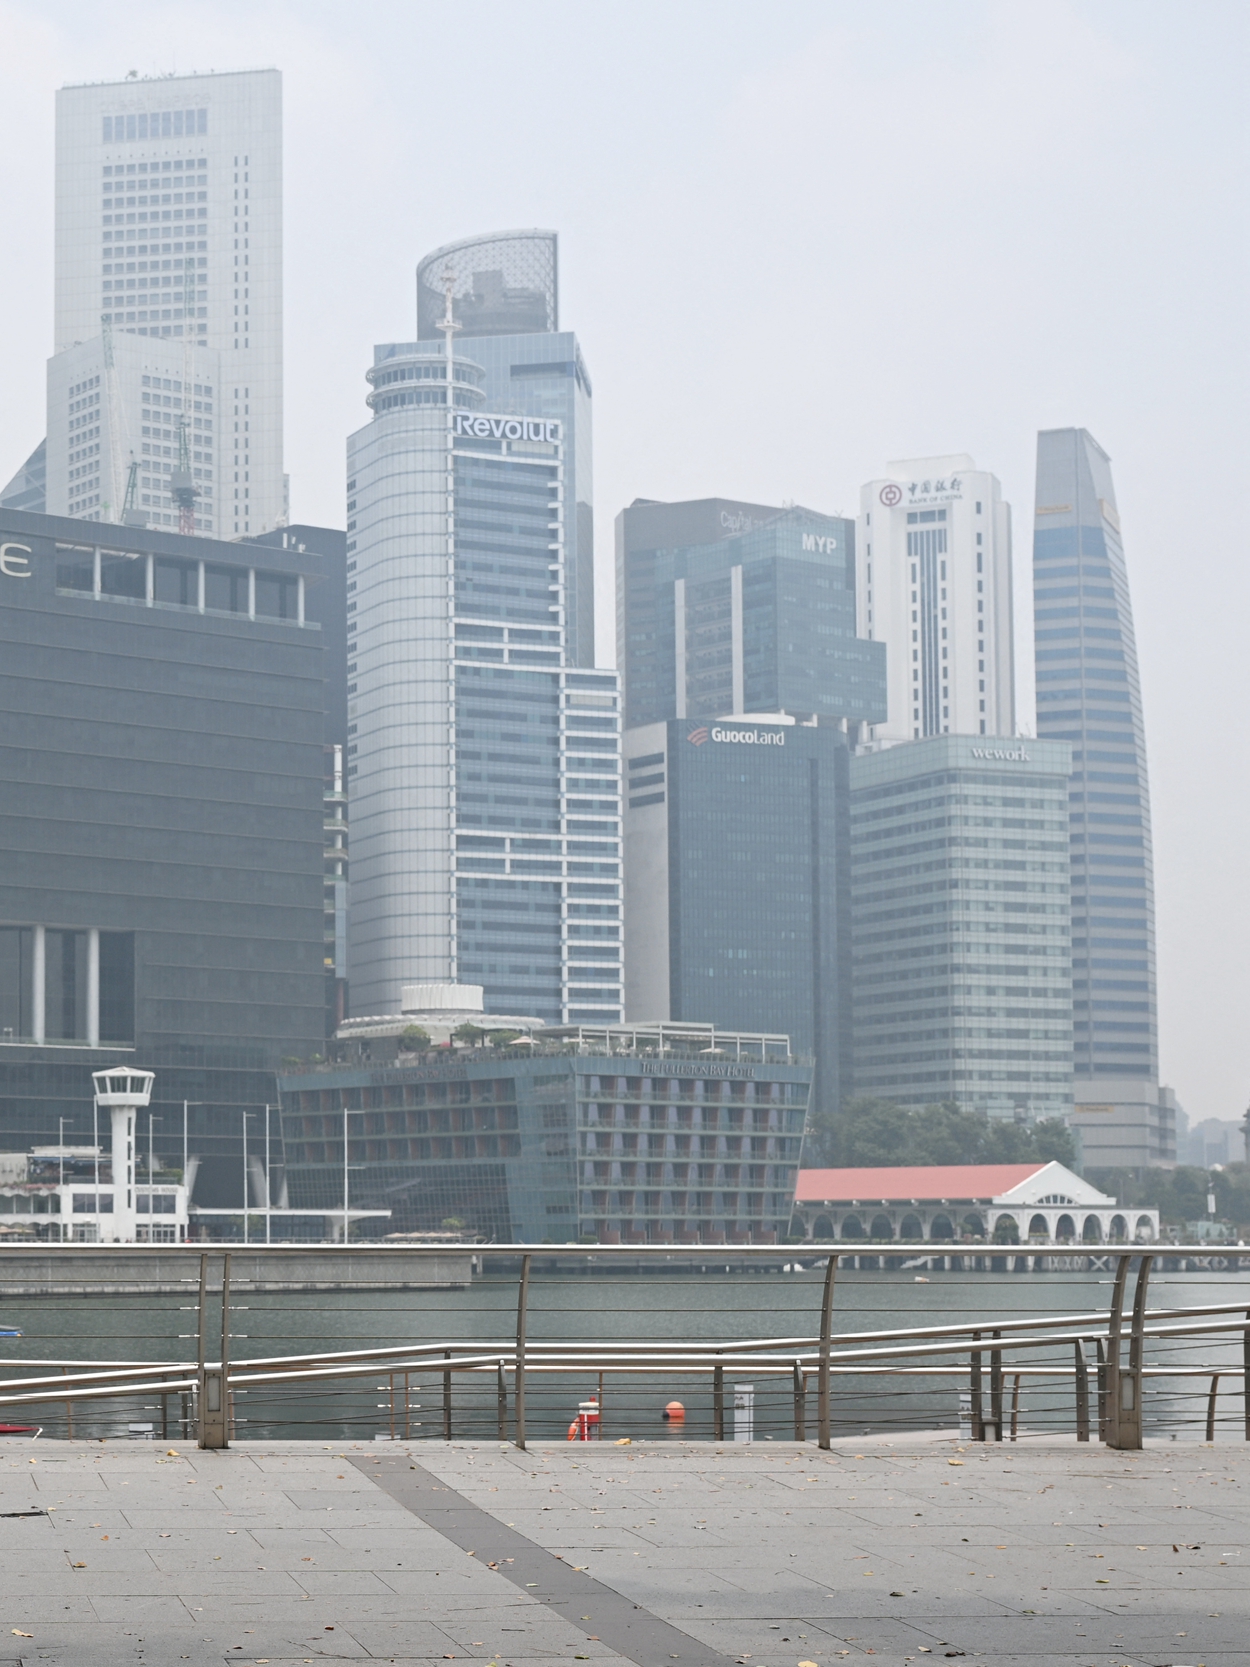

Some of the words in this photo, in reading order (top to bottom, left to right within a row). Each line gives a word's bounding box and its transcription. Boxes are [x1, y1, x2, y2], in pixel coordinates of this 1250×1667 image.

[456, 410, 554, 443] Revolut
[802, 533, 837, 555] MYP
[711, 727, 785, 746] GuocoLand
[971, 745, 1031, 761] wework
[641, 1061, 658, 1074] THE
[660, 1062, 709, 1076] FULLERTON
[710, 1064, 726, 1076] BAY
[727, 1065, 755, 1077] HOTEL
